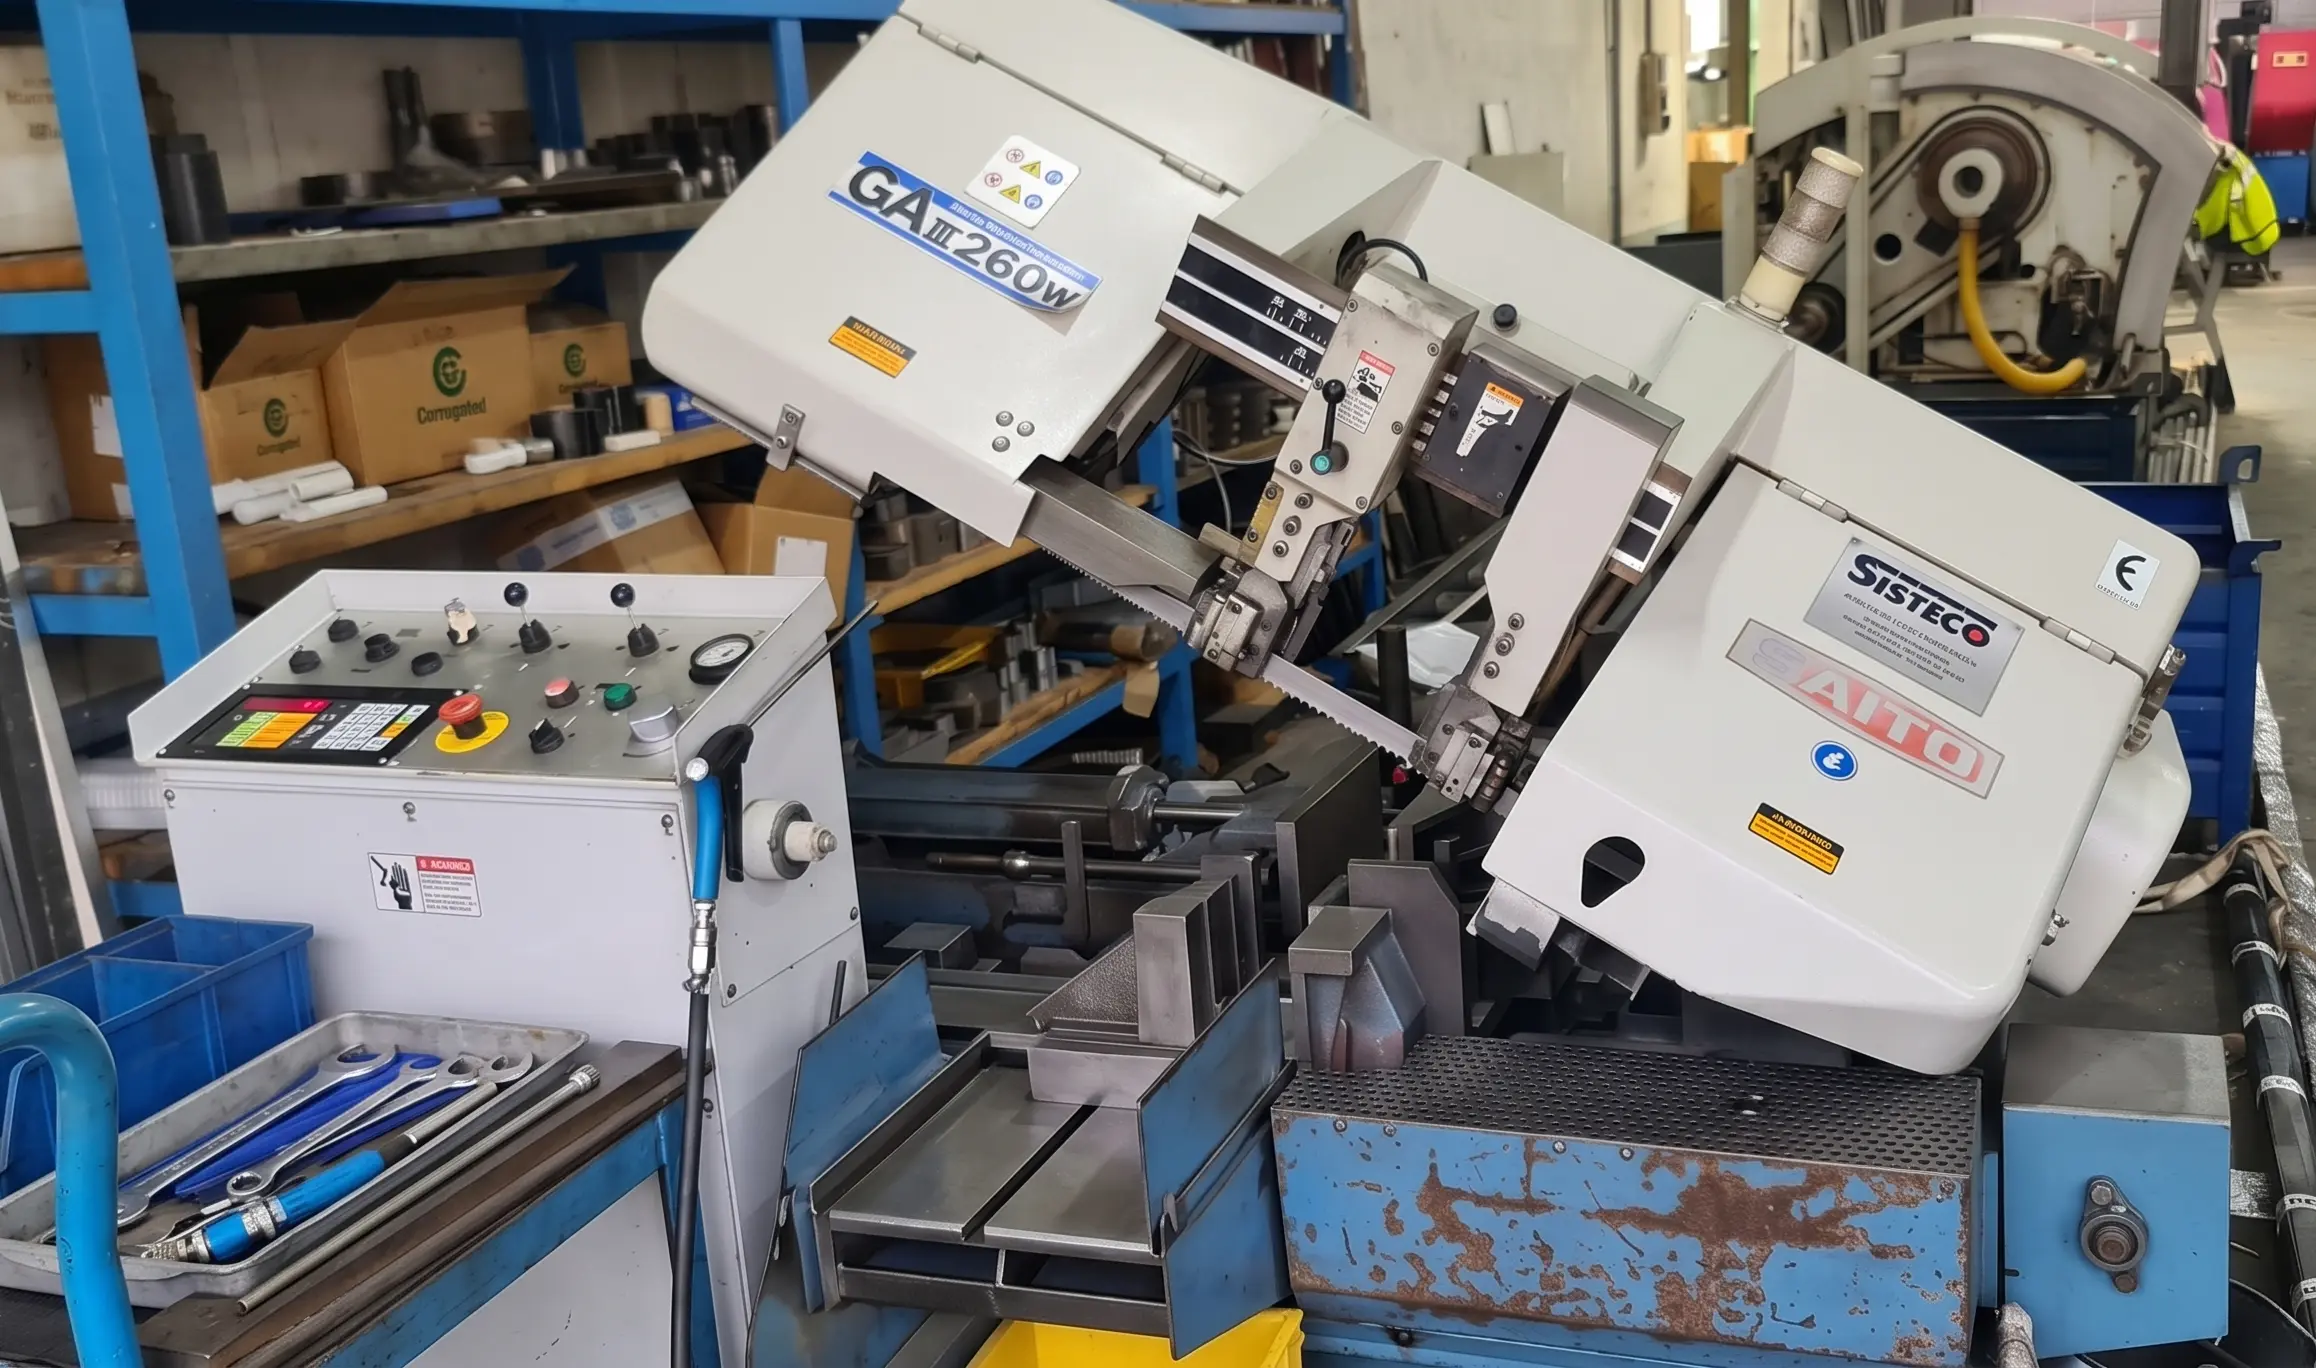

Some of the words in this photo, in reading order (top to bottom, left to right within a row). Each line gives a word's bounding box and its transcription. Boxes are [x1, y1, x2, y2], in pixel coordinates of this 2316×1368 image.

[417, 396, 487, 425] Corrugated
[1847, 553, 1991, 648] SISTECO
[1752, 637, 1982, 780] SAITO
